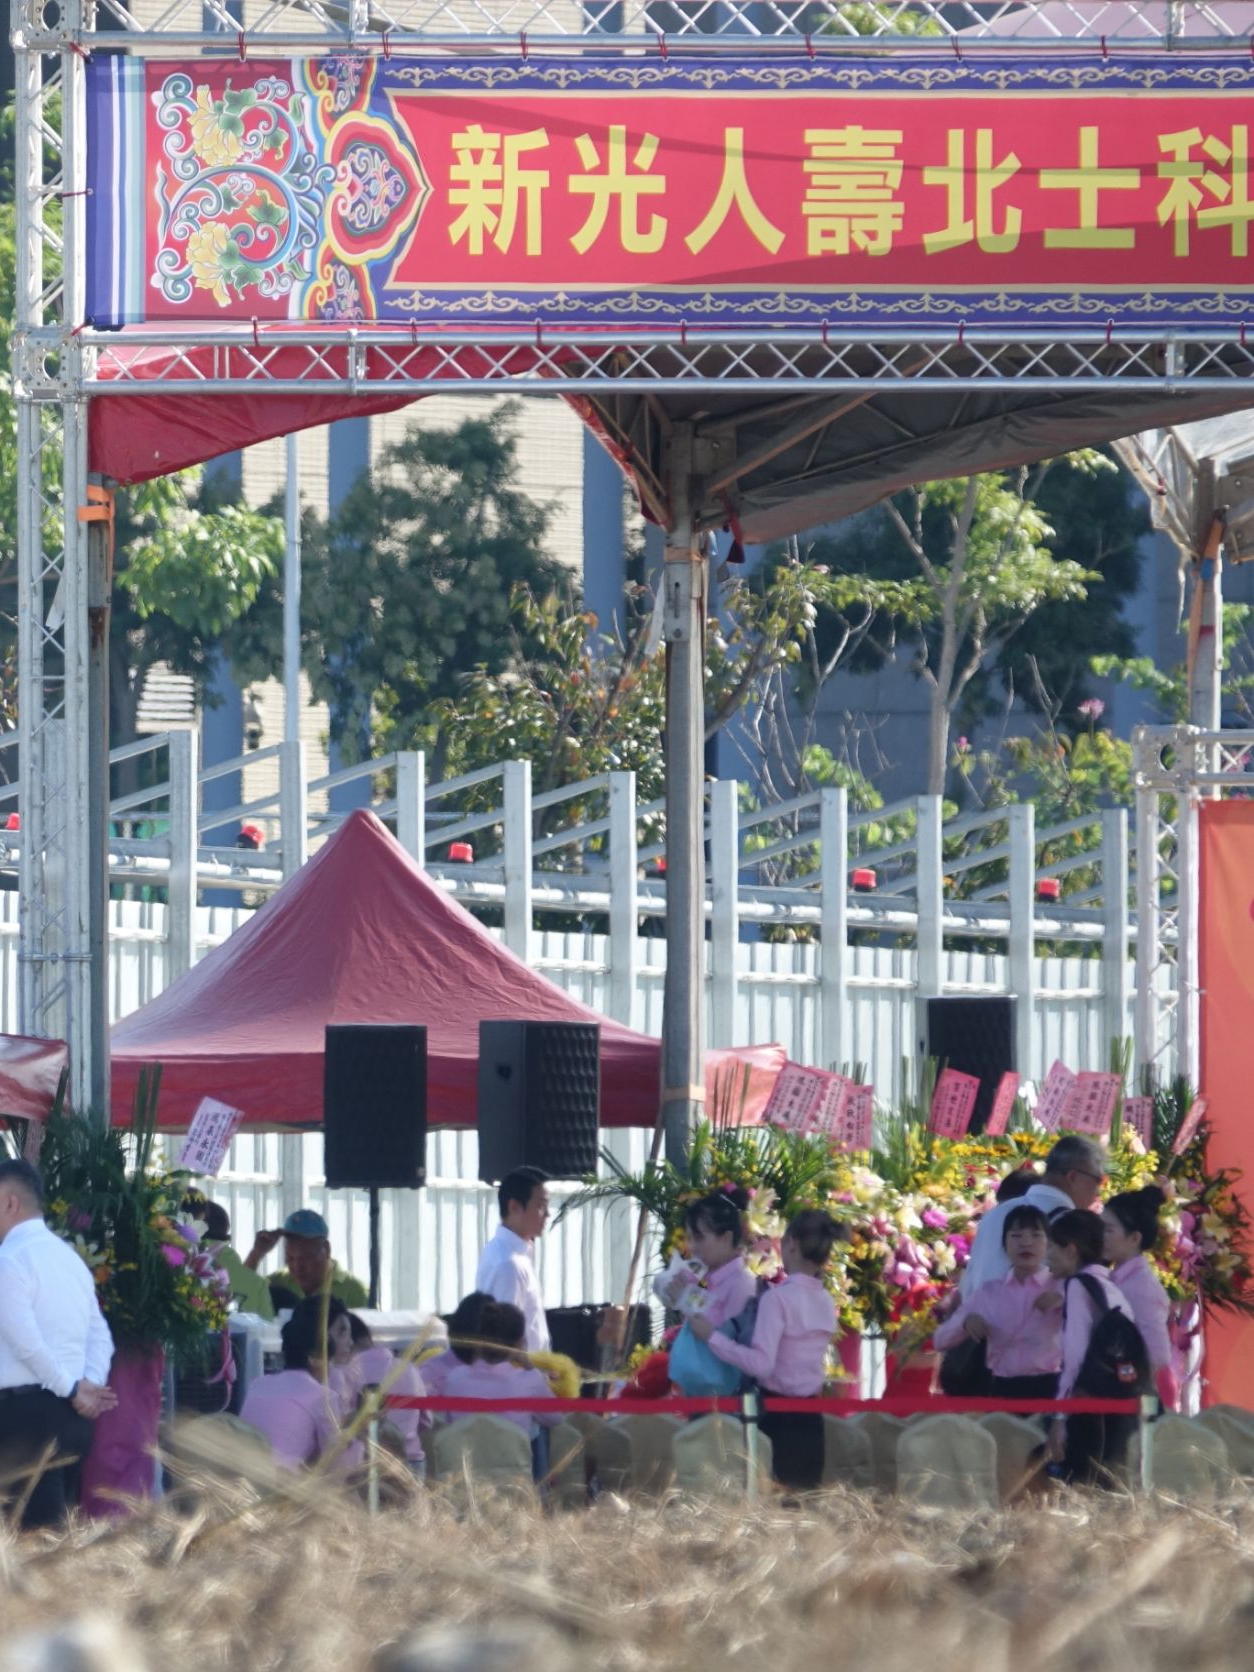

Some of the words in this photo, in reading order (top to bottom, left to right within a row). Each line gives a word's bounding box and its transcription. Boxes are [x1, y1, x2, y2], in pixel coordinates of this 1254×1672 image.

[447, 125, 1254, 257] 新光人壽北士科
